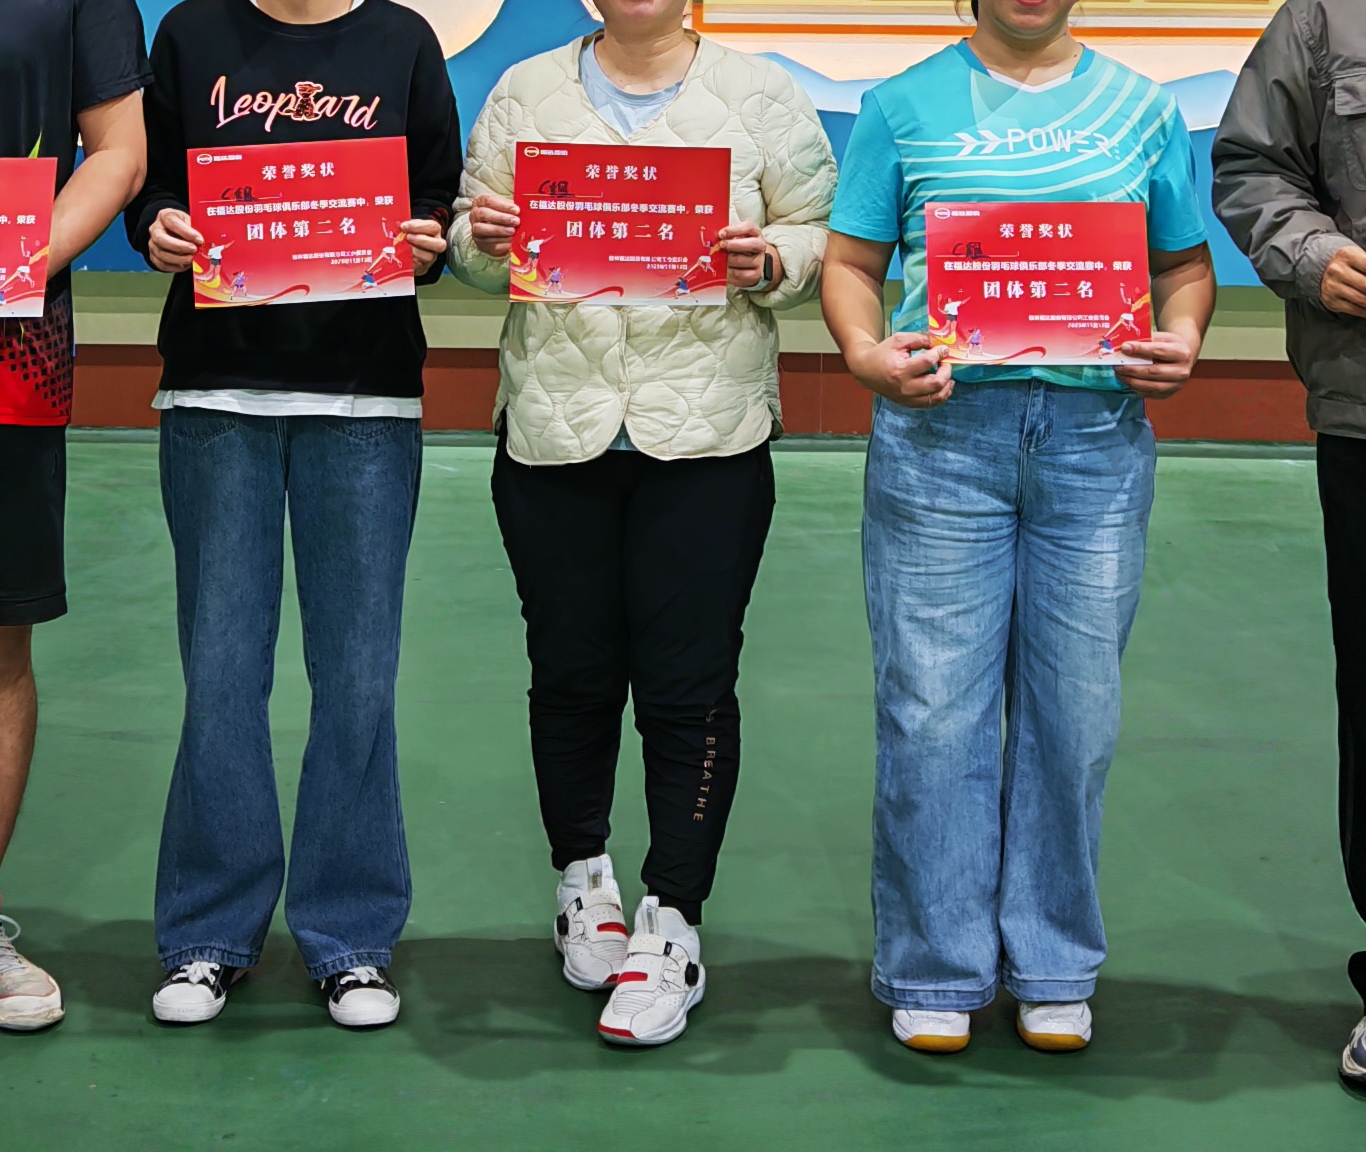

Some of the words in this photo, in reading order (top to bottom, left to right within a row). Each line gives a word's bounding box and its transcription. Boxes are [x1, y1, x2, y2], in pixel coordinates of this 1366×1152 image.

[210, 75, 381, 133] Leopard
[261, 162, 336, 181] 荣誉奖状
[585, 164, 659, 181] 荣誉奖状
[246, 217, 357, 241] 团体第二名
[565, 221, 675, 241] 团体第二名
[999, 223, 1074, 239] 荣誉奖状
[983, 281, 1094, 299] 团体第二名
[692, 735, 717, 823] BREATHE
